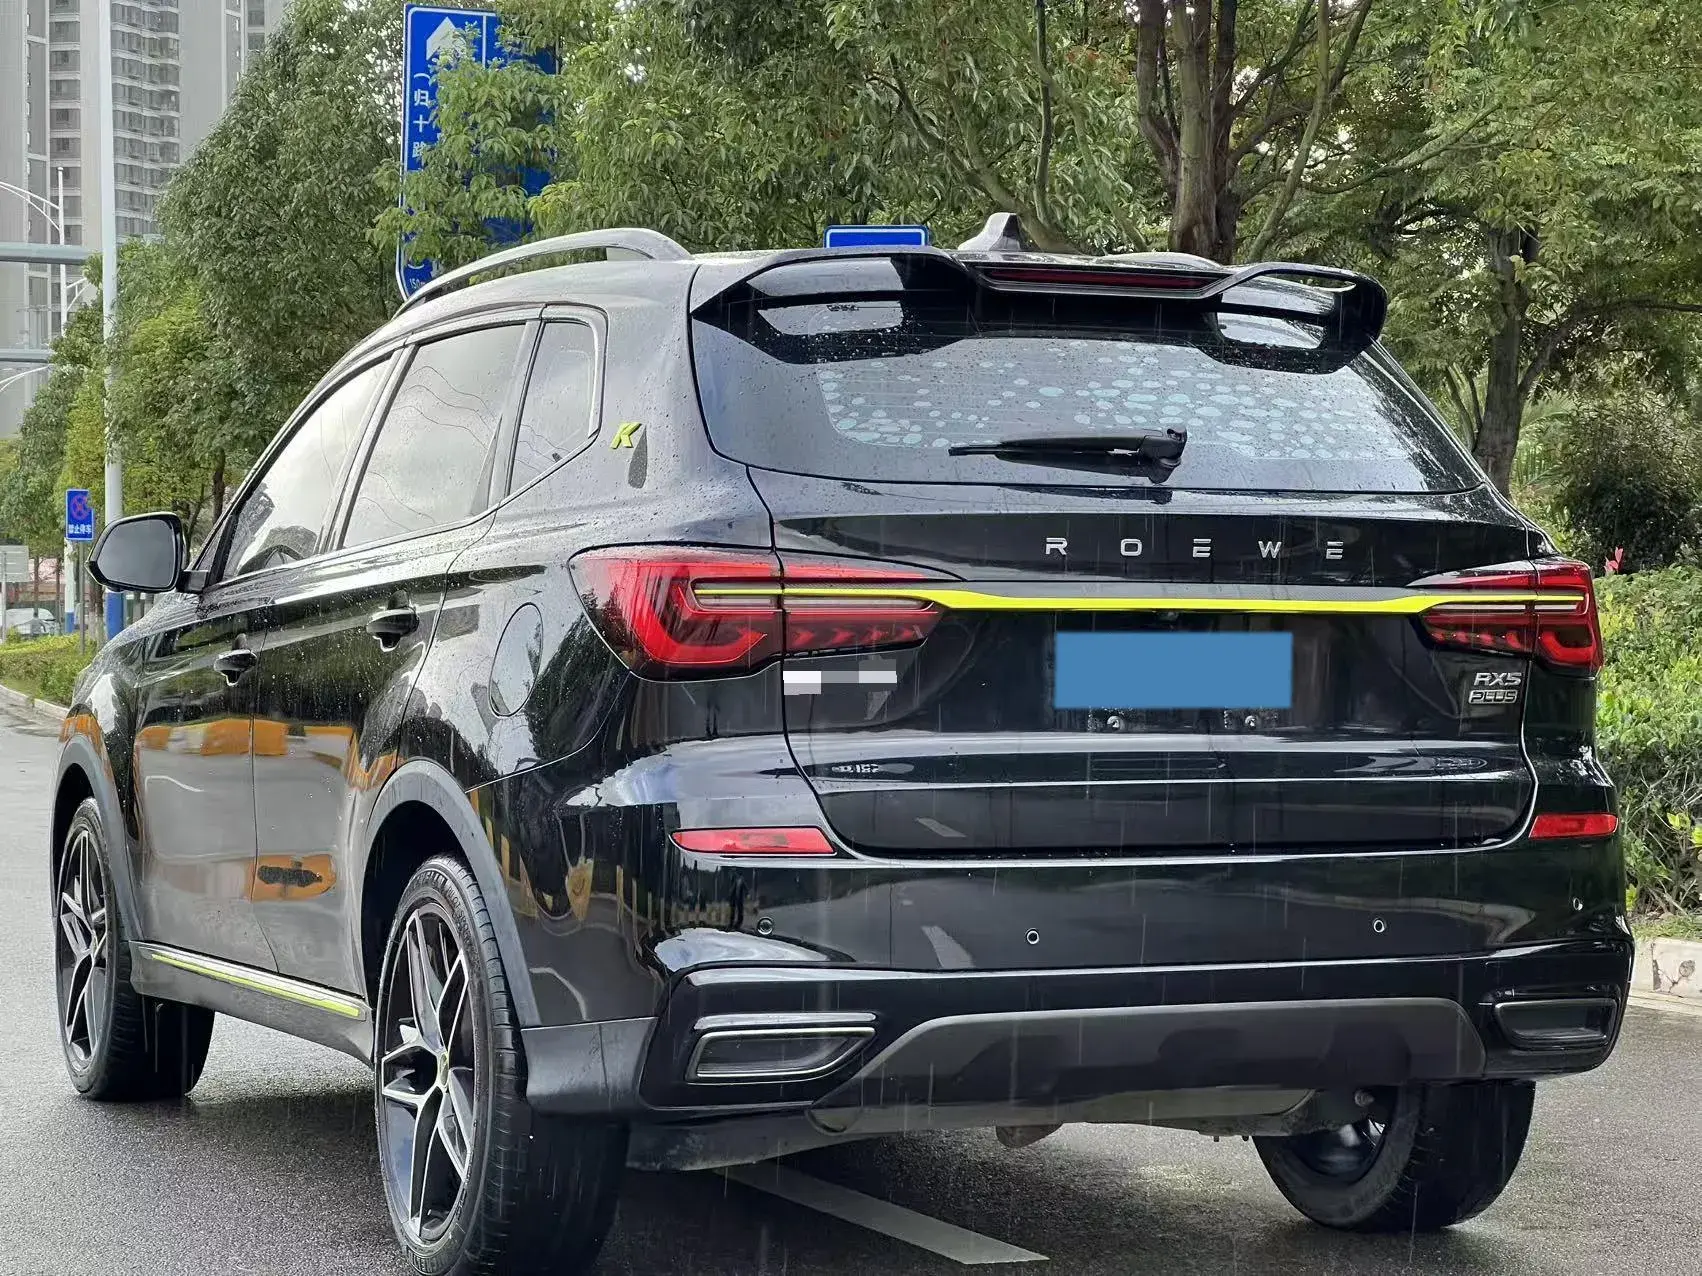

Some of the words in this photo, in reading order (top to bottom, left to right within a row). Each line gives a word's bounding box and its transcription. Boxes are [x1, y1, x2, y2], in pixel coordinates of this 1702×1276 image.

[609, 422, 642, 449] K
[1045, 537, 1344, 560] ROEWE
[1474, 672, 1522, 686] RX5
[1468, 689, 1518, 704] PLUS
